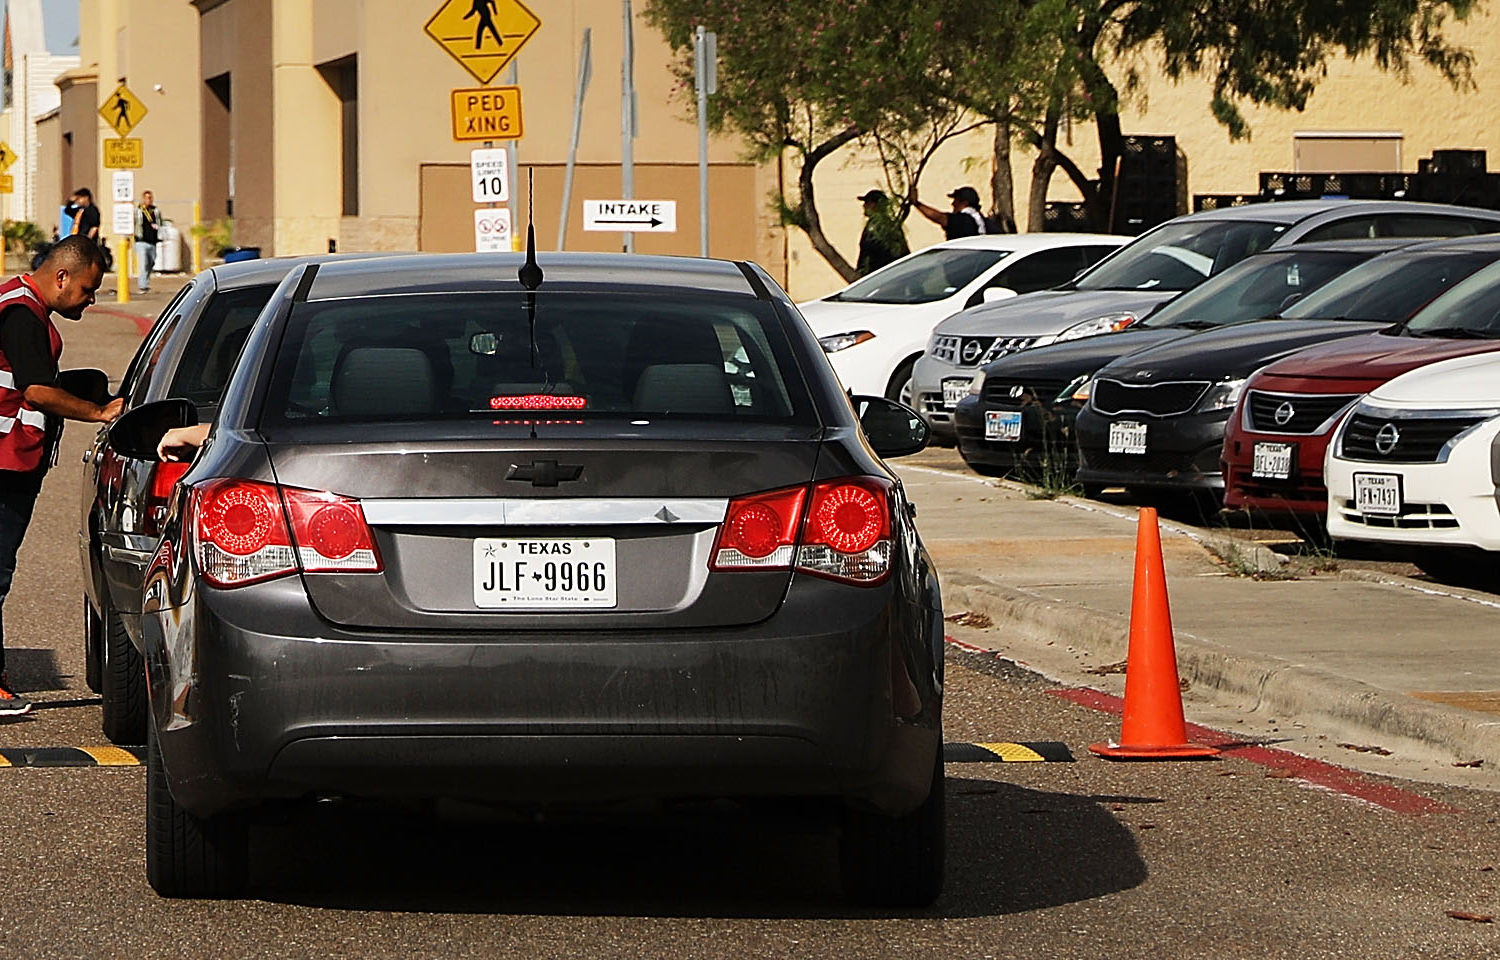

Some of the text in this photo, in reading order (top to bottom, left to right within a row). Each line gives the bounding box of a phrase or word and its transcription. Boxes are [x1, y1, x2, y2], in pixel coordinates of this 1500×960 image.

[468, 96, 505, 111] PED
[465, 116, 510, 132] XING
[479, 177, 502, 195] 10
[599, 203, 661, 215] INTAKE
[518, 543, 572, 555] TEXAS
